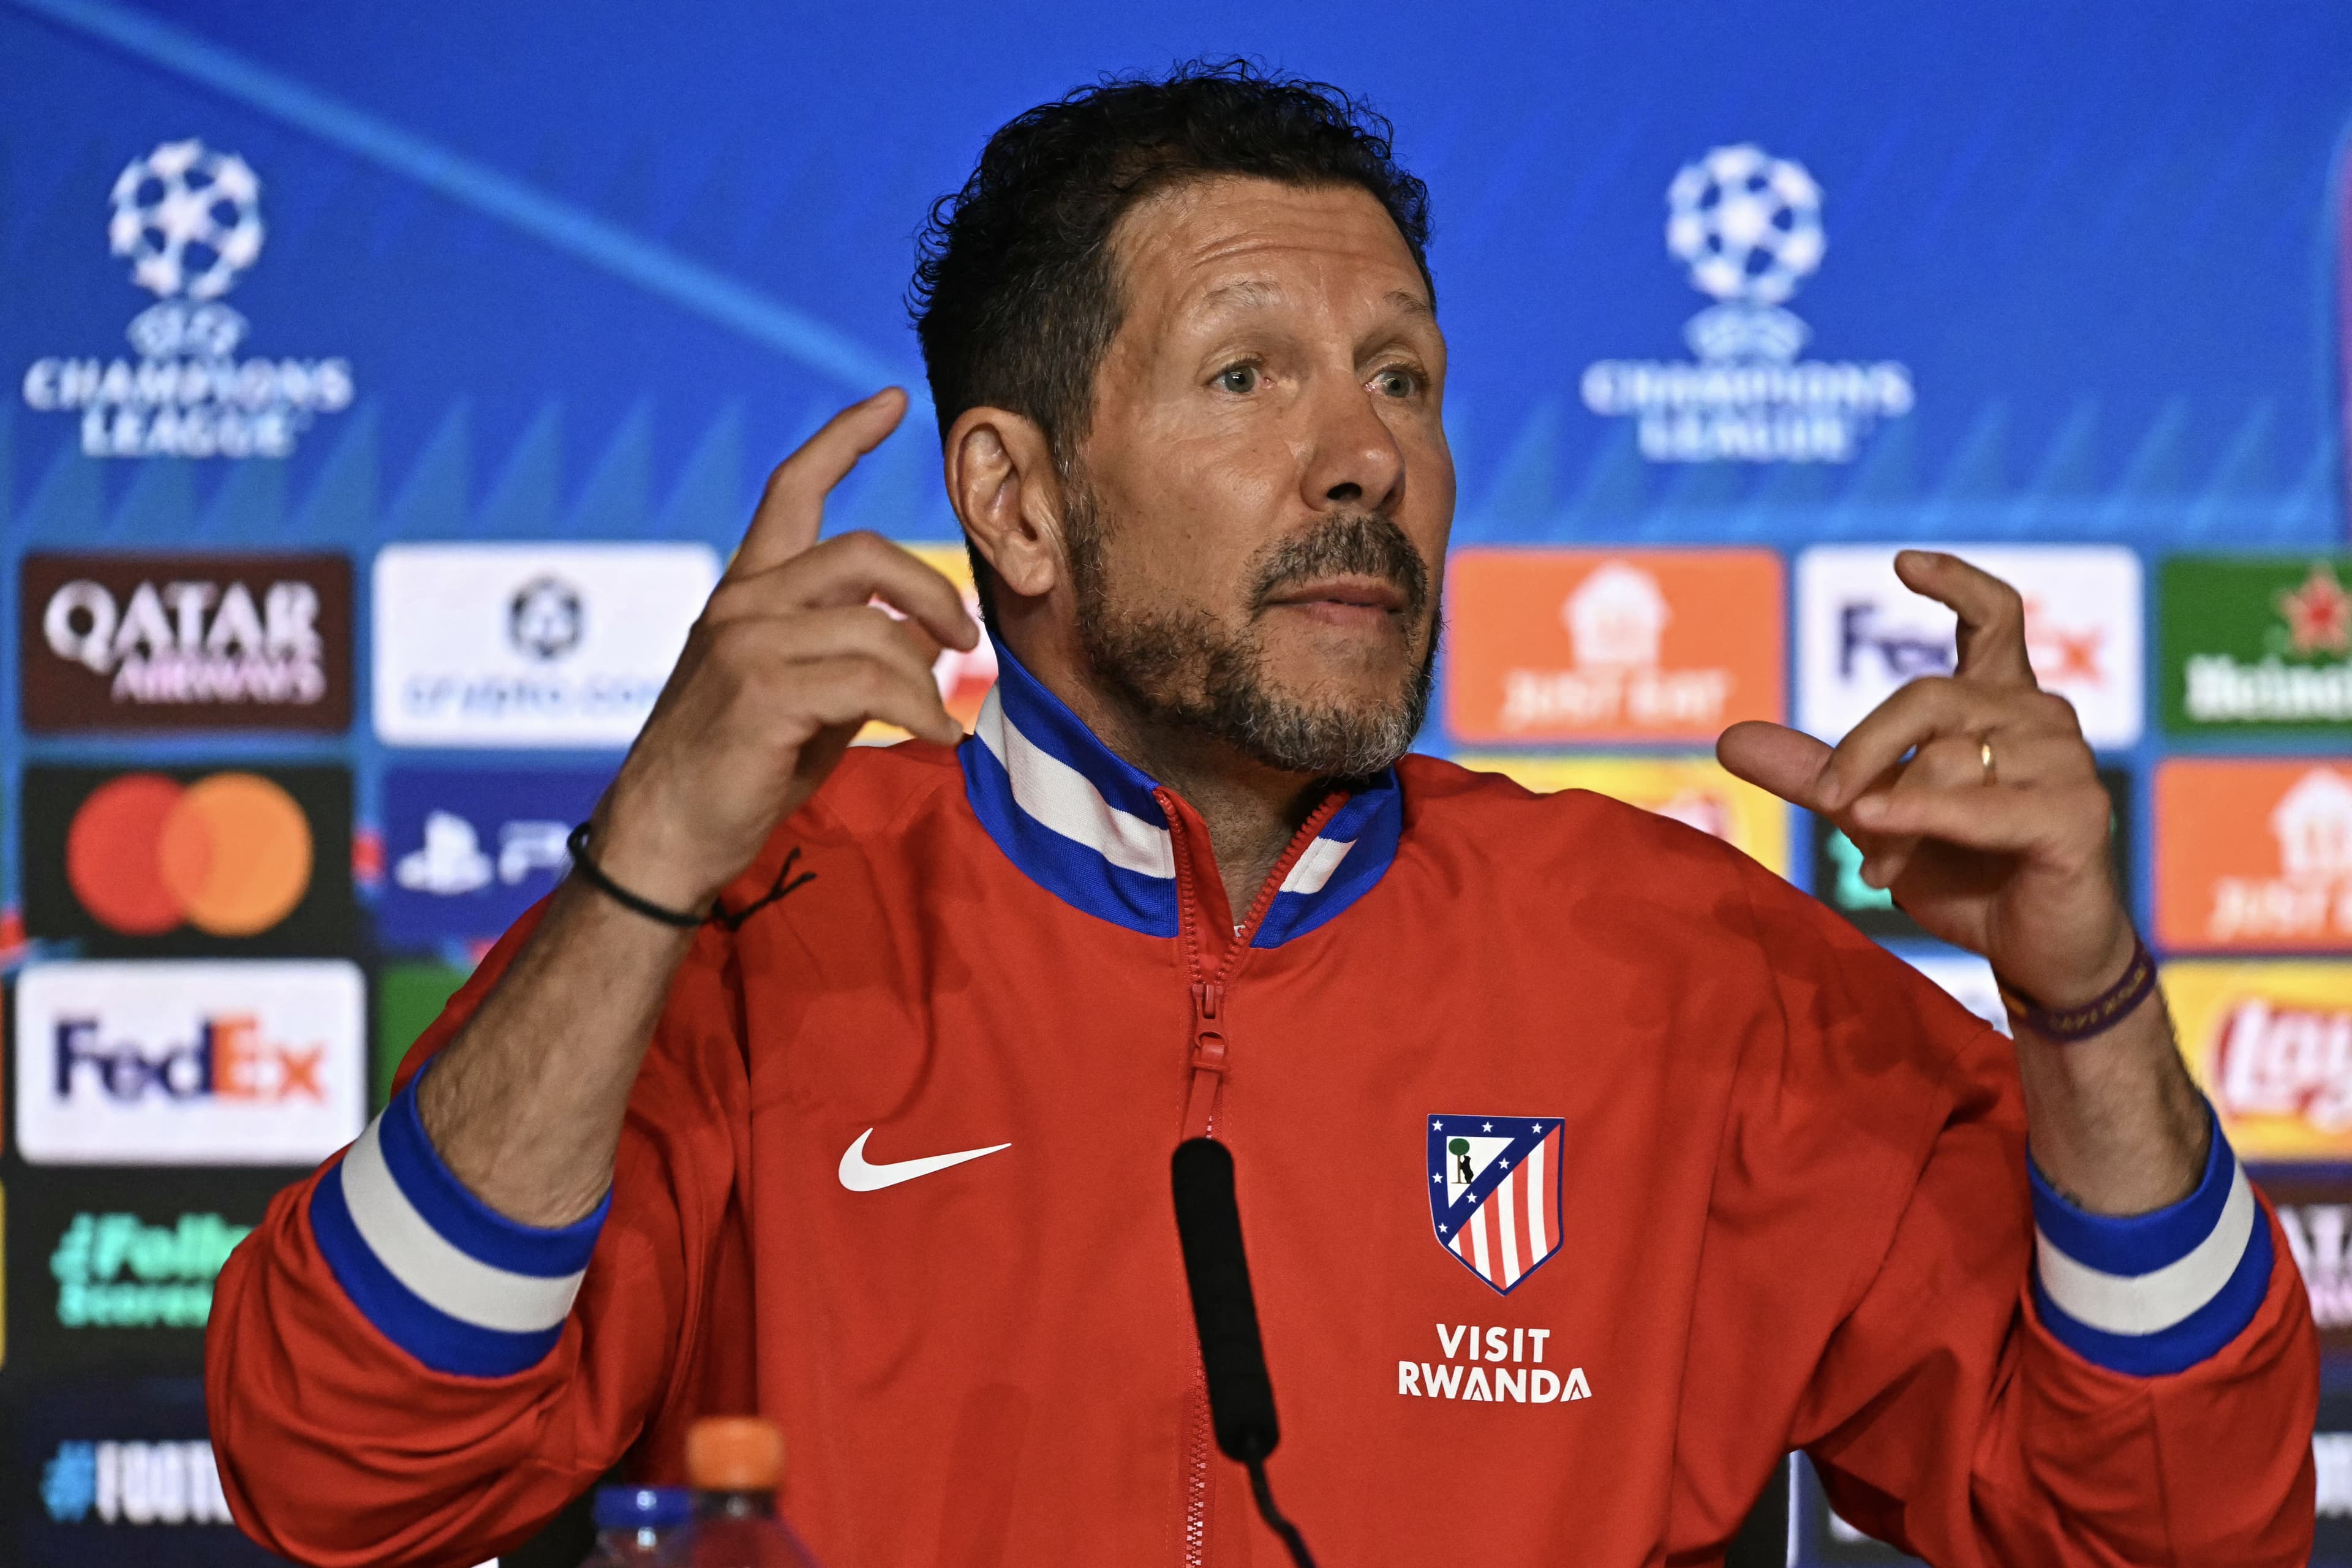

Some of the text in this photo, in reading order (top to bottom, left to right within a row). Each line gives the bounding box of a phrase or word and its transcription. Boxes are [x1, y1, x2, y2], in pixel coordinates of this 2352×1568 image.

[23, 357, 353, 412] CHAMPIONS
[82, 407, 295, 457] LEAGUE
[43, 579, 323, 674] QATAR
[53, 1014, 327, 1101] FedEx
[1436, 1323, 1550, 1363] VISIT
[1398, 1360, 1593, 1403] RWANDA
